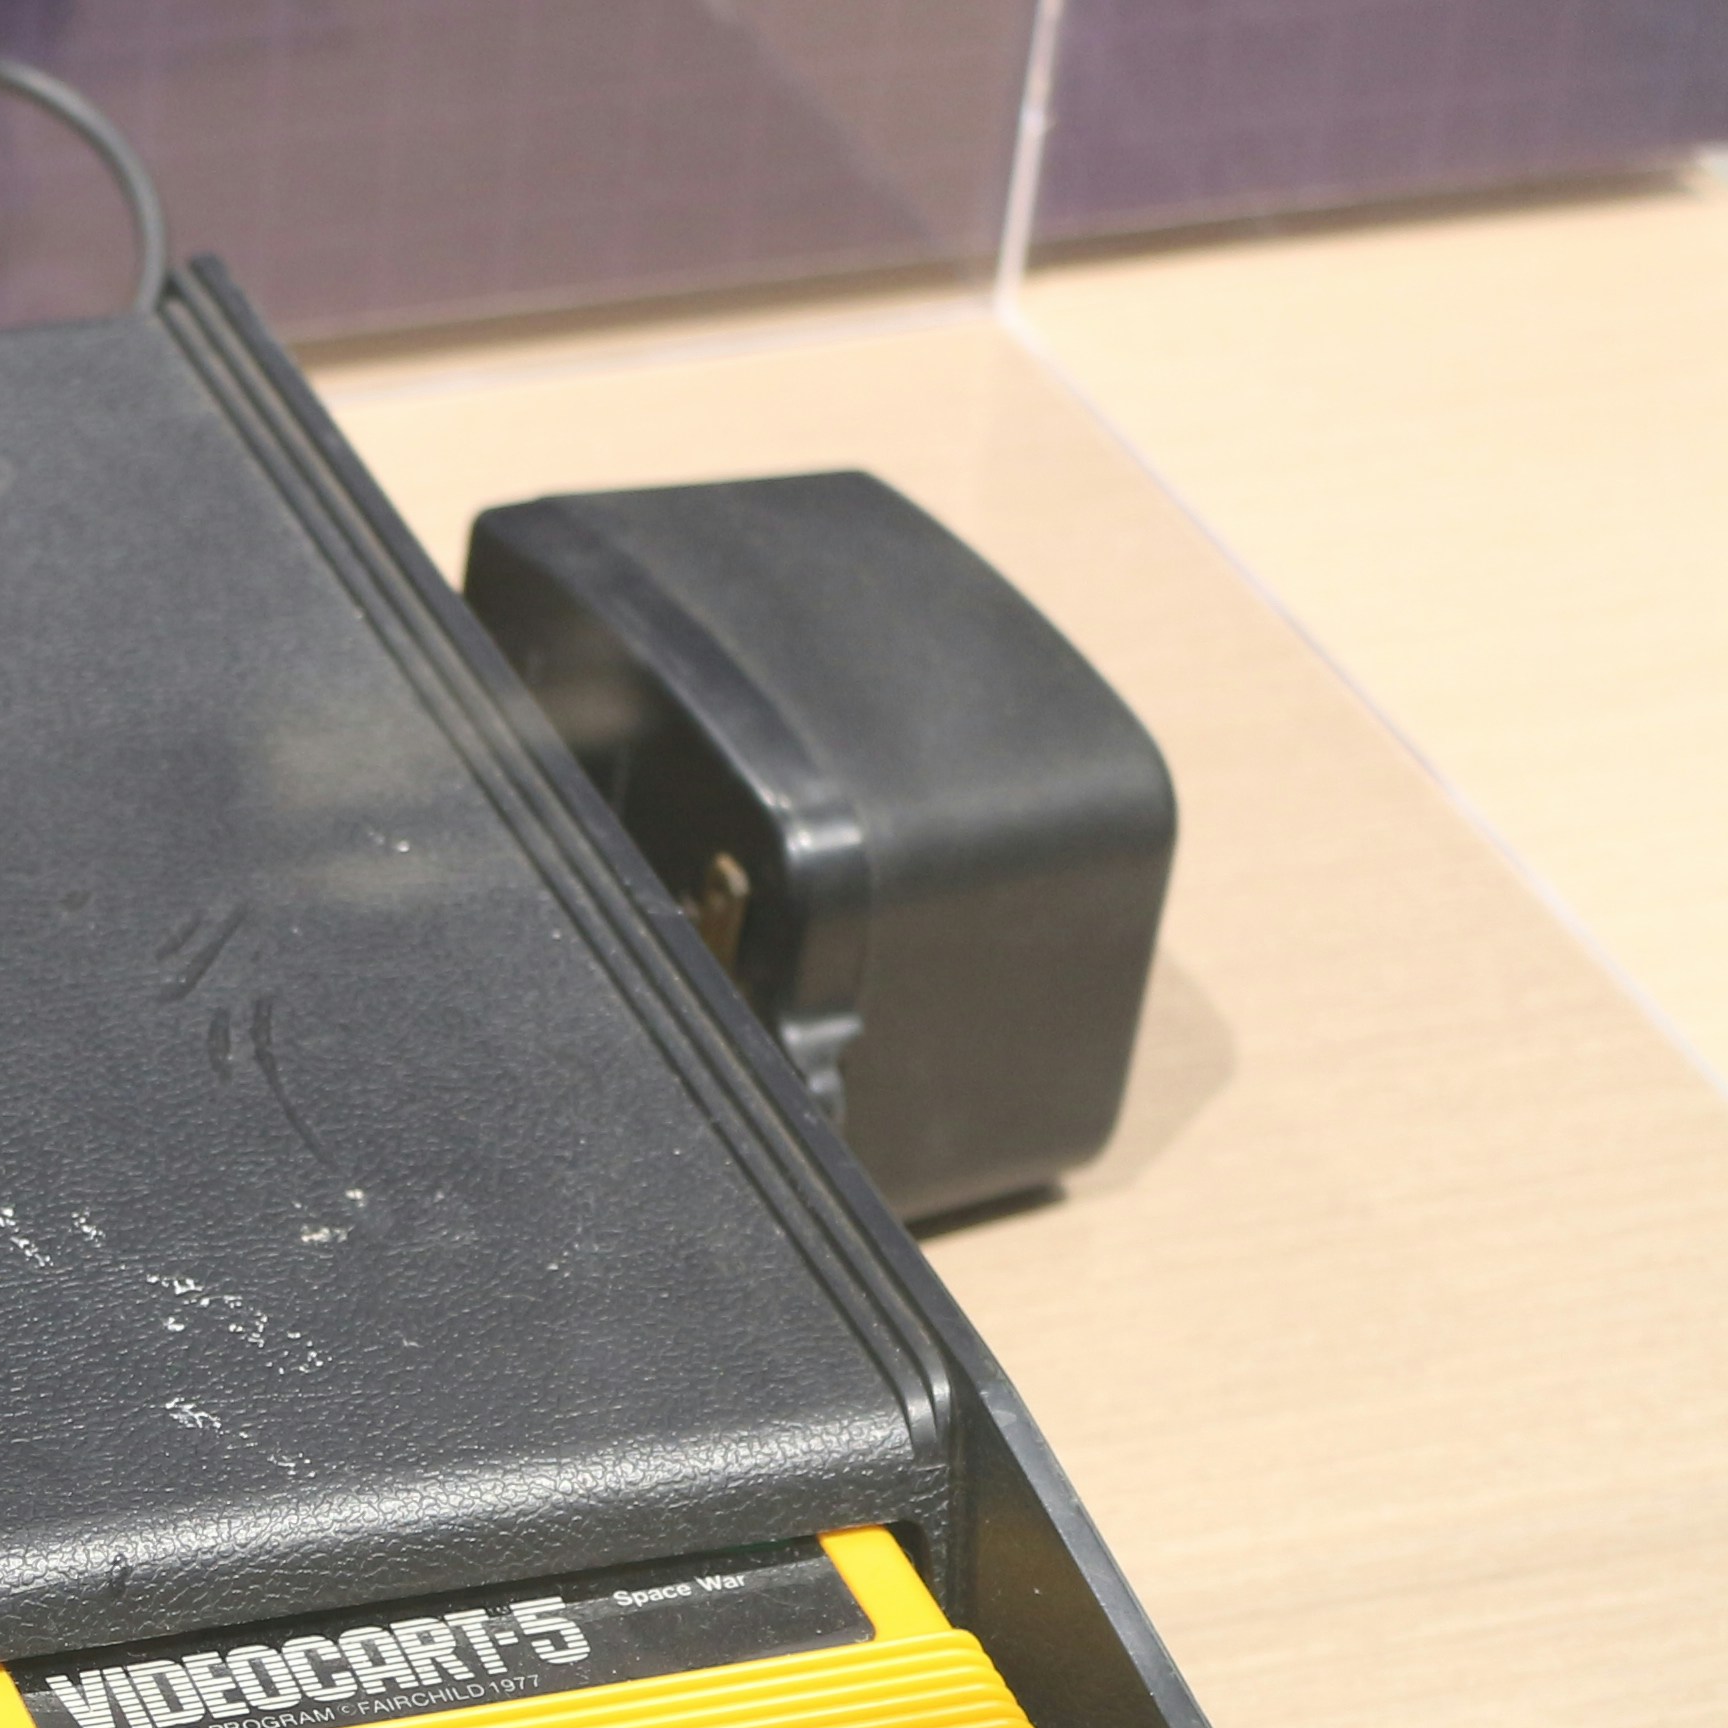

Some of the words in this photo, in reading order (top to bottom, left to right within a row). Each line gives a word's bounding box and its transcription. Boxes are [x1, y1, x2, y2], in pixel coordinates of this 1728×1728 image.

[613, 1580, 692, 1608] Space
[693, 1574, 746, 1593] War
[489, 1674, 540, 1696] 1977
